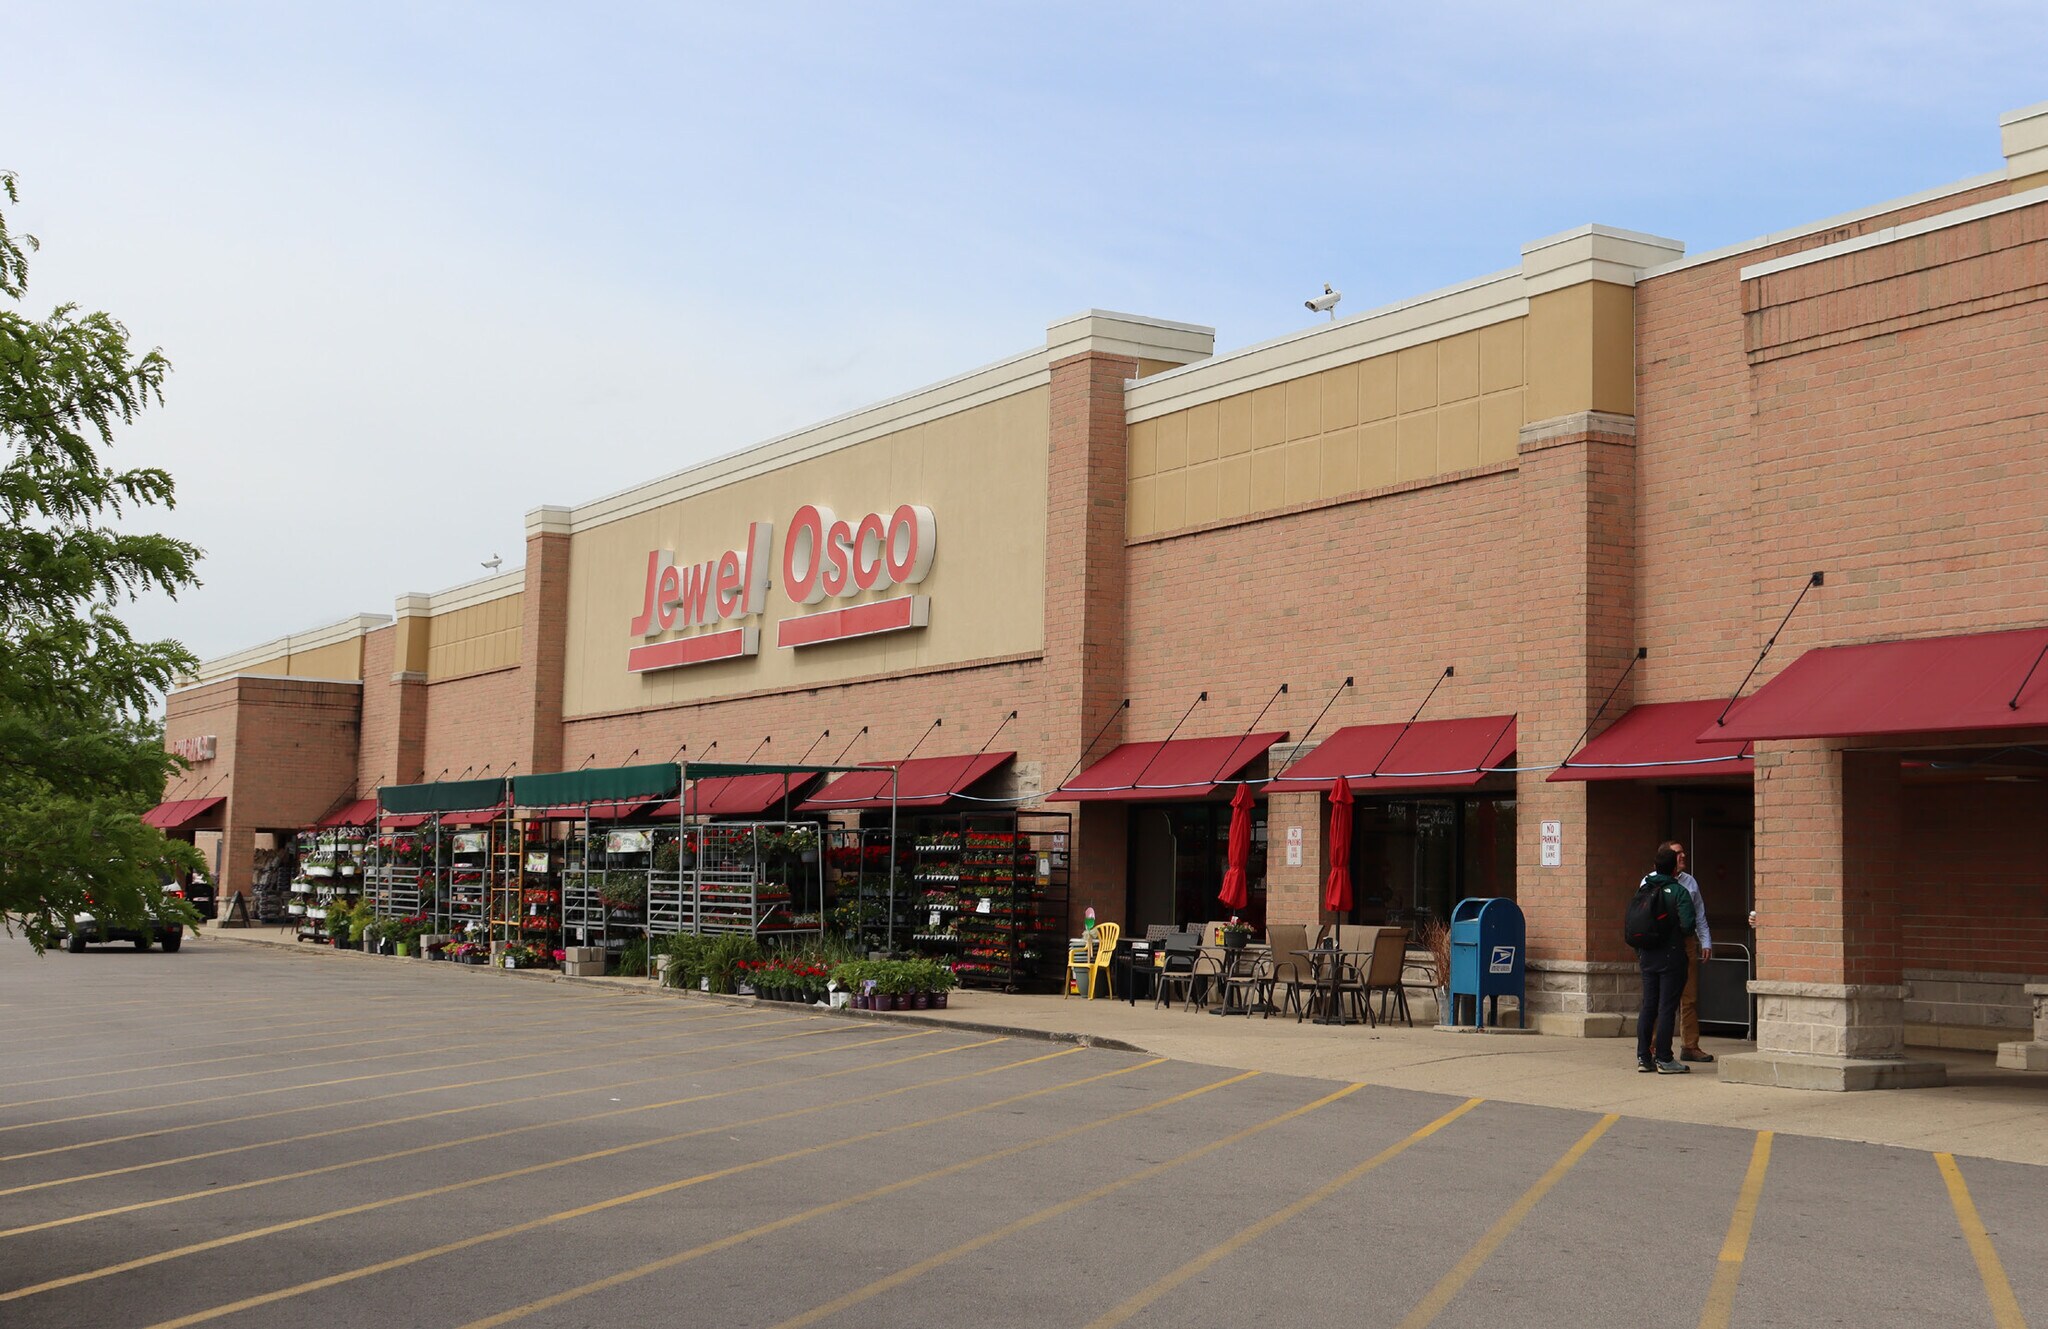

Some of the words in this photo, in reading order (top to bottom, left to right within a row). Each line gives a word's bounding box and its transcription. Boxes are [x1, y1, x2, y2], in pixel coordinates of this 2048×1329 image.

[630, 522, 760, 637] Jewel
[782, 504, 924, 604] Osco
[1546, 825, 1555, 834] NO
[1542, 835, 1560, 844] PARKING
